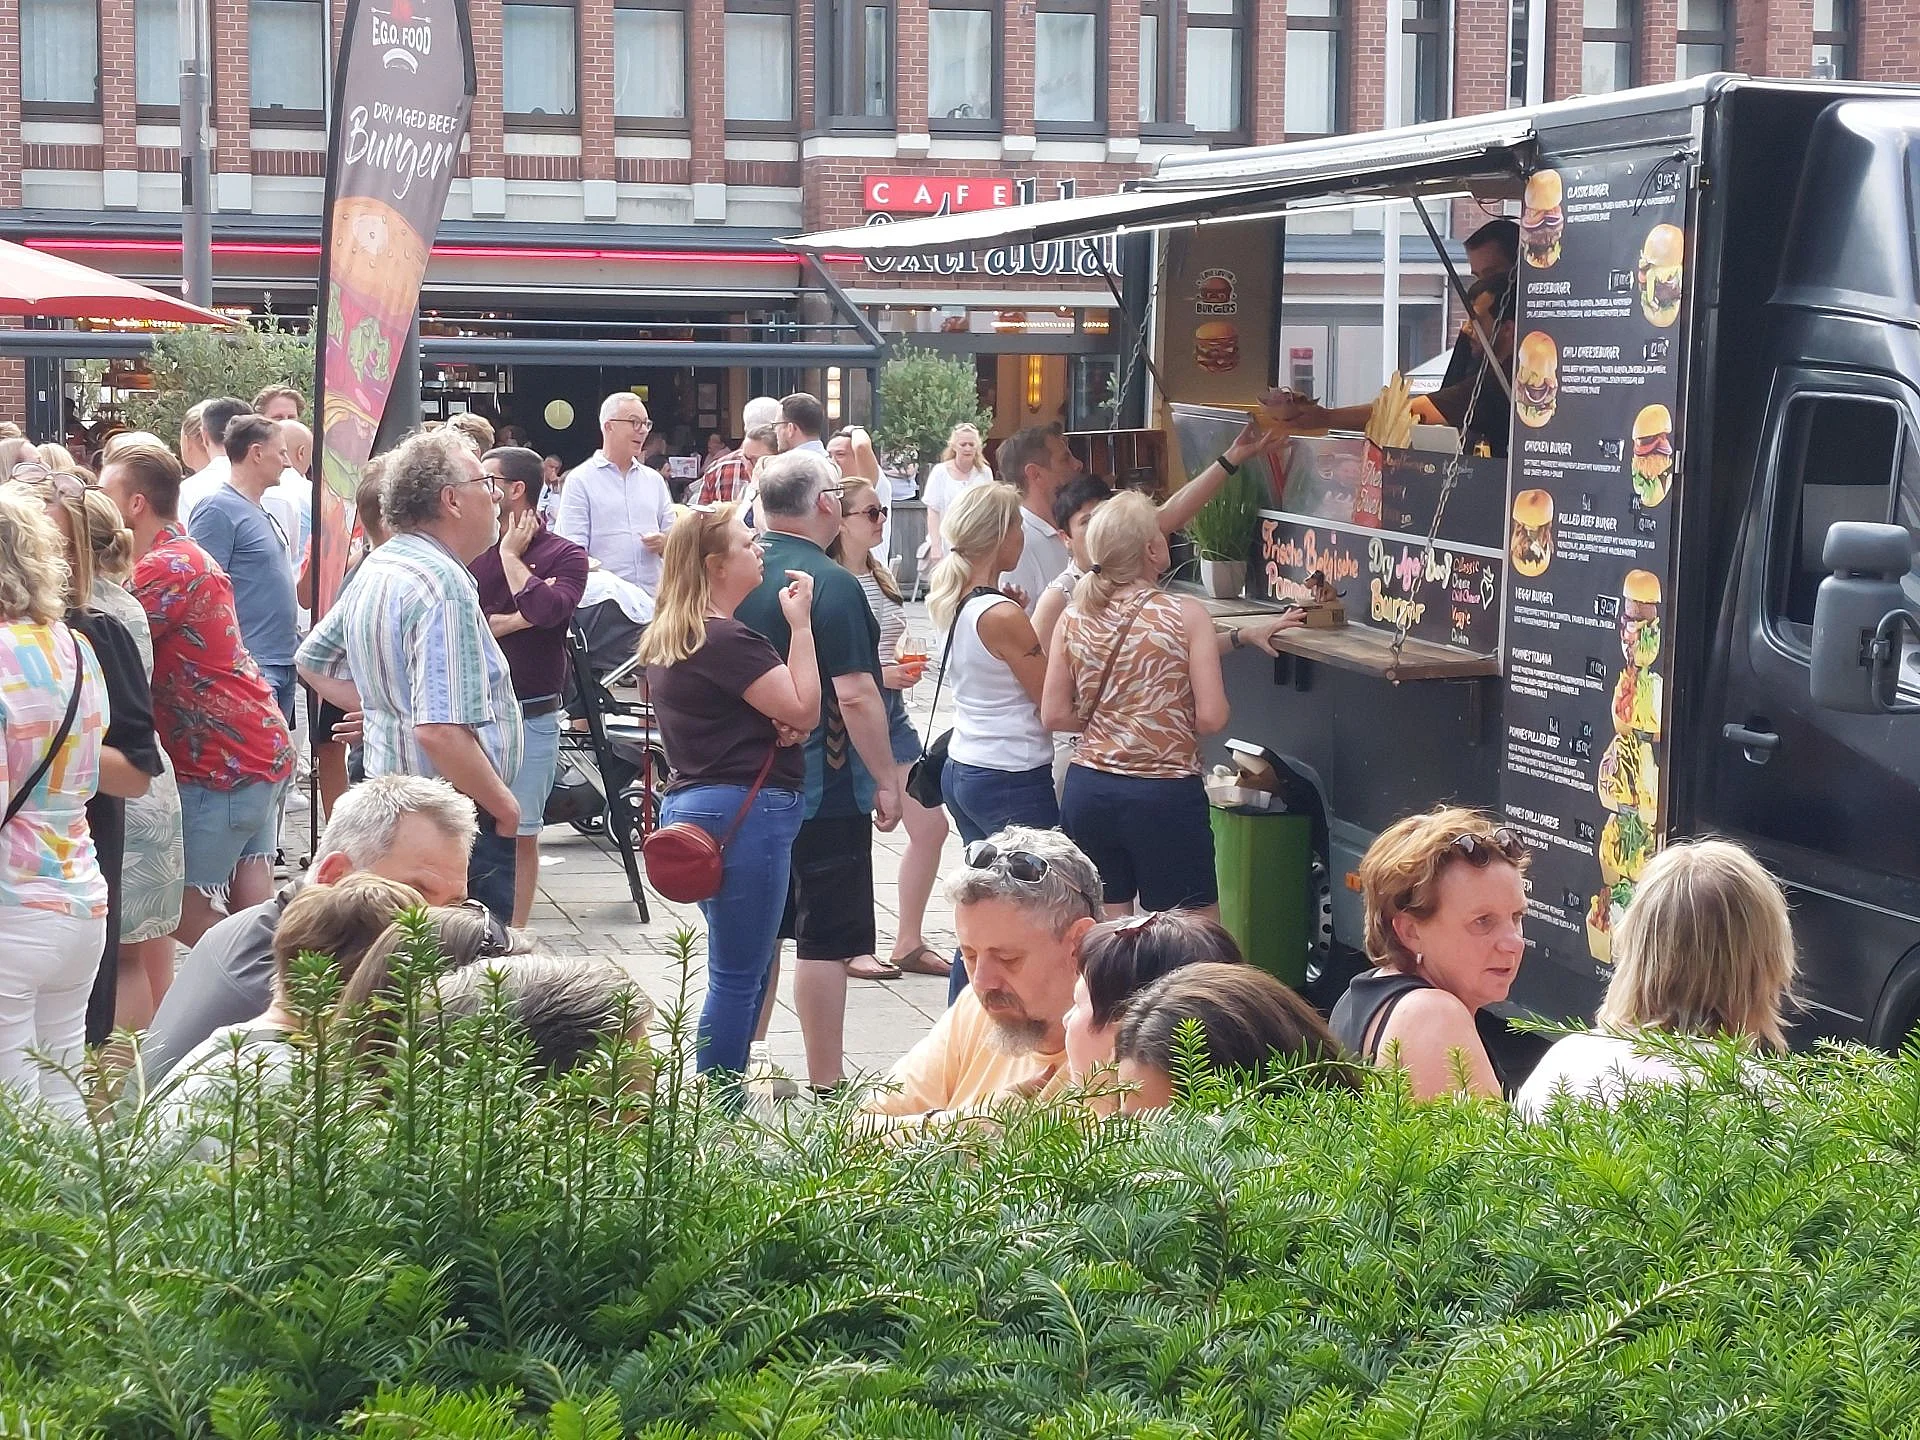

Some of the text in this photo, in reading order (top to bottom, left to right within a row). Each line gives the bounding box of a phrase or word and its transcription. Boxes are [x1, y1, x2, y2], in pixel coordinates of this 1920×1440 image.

[402, 26, 432, 55] FOOD
[373, 101, 458, 134] DRY AGED BEEF
[345, 105, 453, 200] Burger
[872, 182, 1006, 206] CAFE
[1589, 183, 1609, 198] BURGER
[1528, 281, 1571, 295] CHEESEBURGER
[1196, 303, 1236, 313] BURGERS
[1578, 345, 1620, 360] CHEESEBURGER
[1524, 440, 1572, 456] CHICKEN BURGER
[1559, 512, 1617, 532] PULLED BEEF BURGER
[1262, 519, 1303, 567] Frische
[1369, 537, 1395, 588] Dry
[1531, 589, 1554, 607] BURGER
[1546, 734, 1560, 748] BEEF
